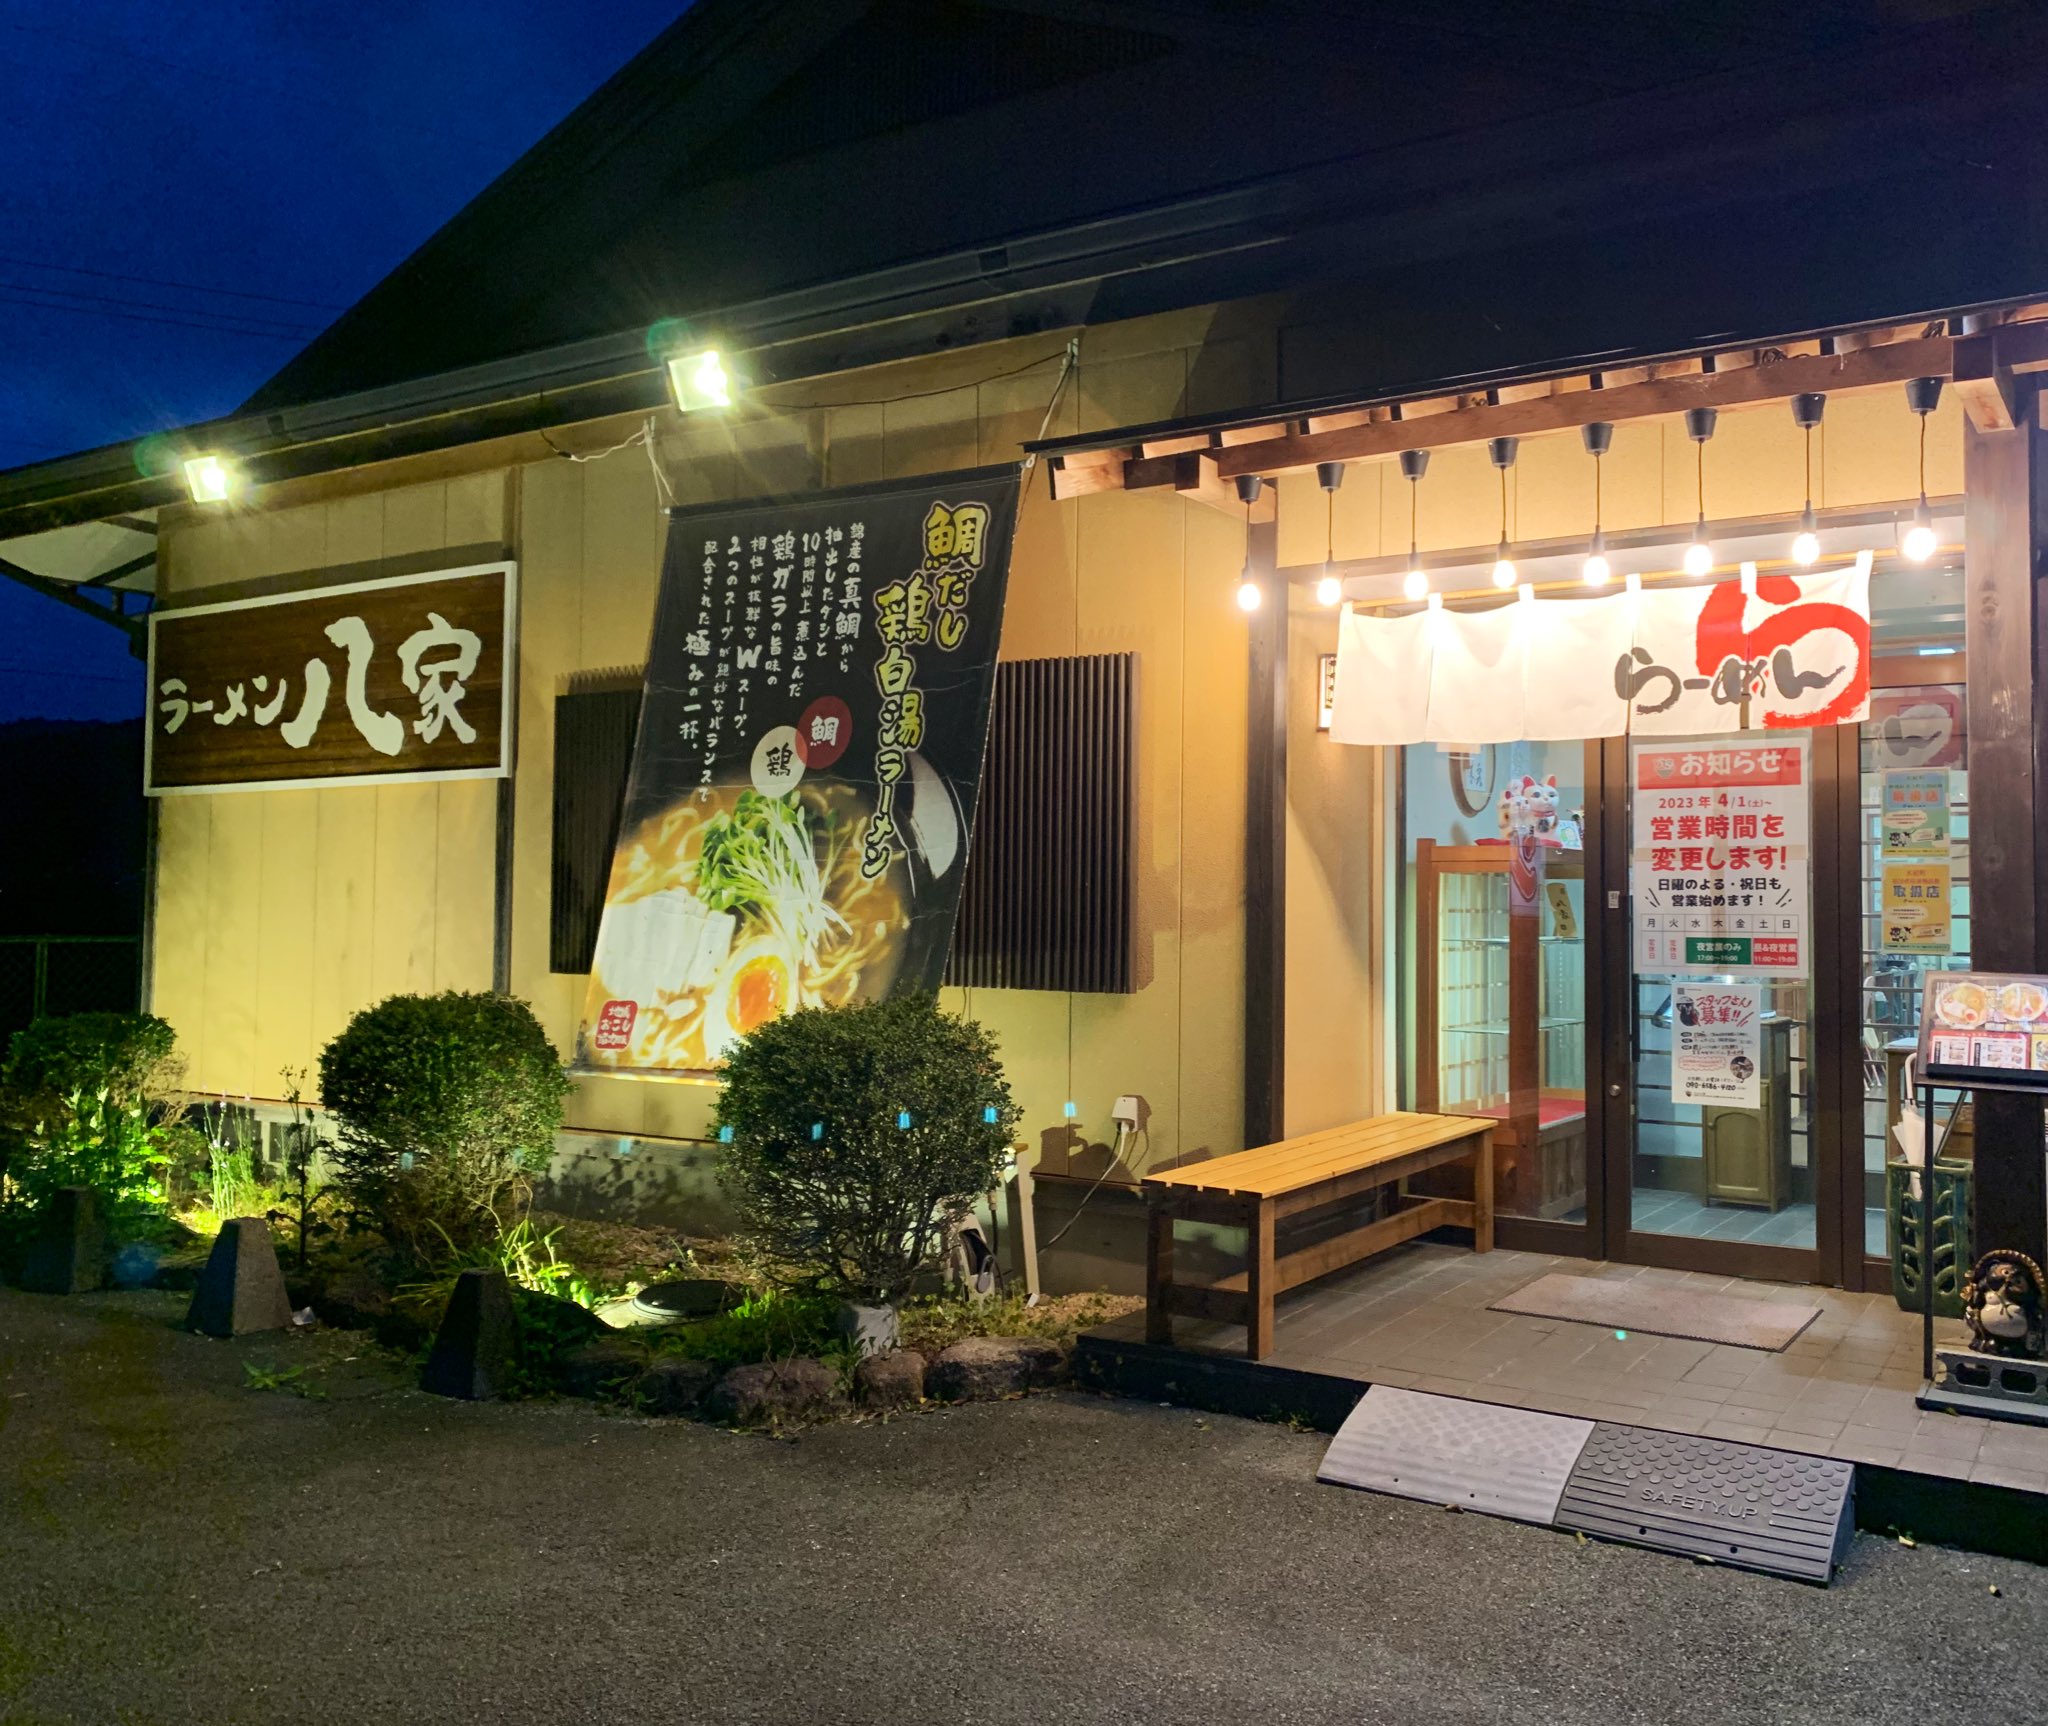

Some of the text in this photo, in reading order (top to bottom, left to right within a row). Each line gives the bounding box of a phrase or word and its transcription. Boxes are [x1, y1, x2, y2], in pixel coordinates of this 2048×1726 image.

[925, 503, 990, 650] 鯛だし
[765, 529, 796, 686] 鶏ガラの旨味の
[789, 532, 821, 697] 10時間以上煮込んだ
[1613, 645, 1847, 715] らーめん
[810, 714, 840, 748] 鯛
[861, 572, 932, 882] 鶏白湯ラーメン
[765, 741, 794, 777] 鶏
[1679, 750, 1782, 777] お知らせ
[1650, 814, 1785, 841] 営業時間を
[1657, 877, 1782, 891] 日曜のよる・祝日も
[1646, 918, 1656, 928] 月
[1668, 918, 1679, 928] 火
[1691, 918, 1701, 928] 水
[1713, 918, 1724, 928] 木
[1736, 918, 1746, 929] 金
[1759, 919, 1768, 929] 土
[1782, 919, 1791, 929] 日
[1695, 994, 1753, 1008] スタッフさん
